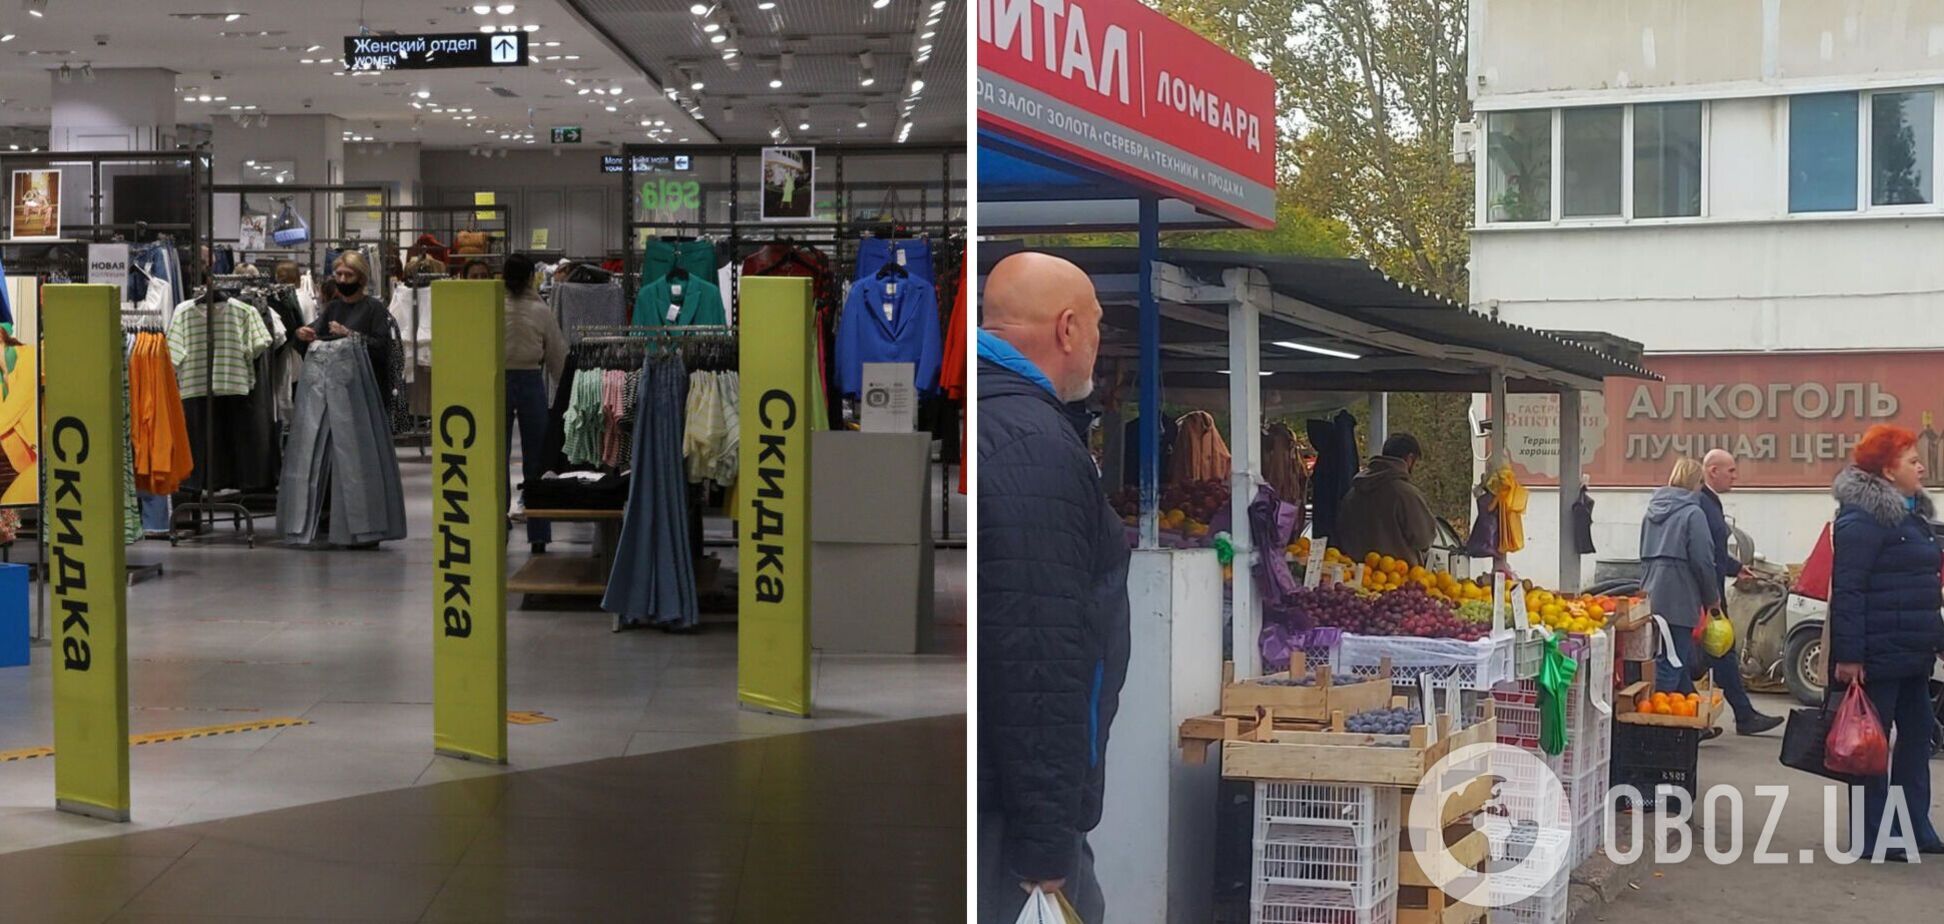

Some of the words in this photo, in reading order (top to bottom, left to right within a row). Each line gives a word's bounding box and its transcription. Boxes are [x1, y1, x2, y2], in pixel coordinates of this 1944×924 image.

[353, 37, 426, 54] Женский
[430, 38, 477, 54] отдел
[354, 55, 397, 67] WOMEN
[1157, 71, 1260, 153] ЛОМБАРД
[999, 87, 1044, 120] ЗАЛОГ
[1154, 150, 1199, 181] ТЕХНИКИ
[1207, 172, 1245, 199] ПРОДАЖА
[91, 261, 125, 270] НОВАЯ
[1626, 382, 1898, 419] АЛКОГОЛЬ
[1625, 433, 1777, 460] ЛУЧШАЯ
[1790, 433, 1856, 463] ЦЕН
[438, 404, 477, 639] Скидка
[751, 388, 797, 605] Скидка
[52, 416, 91, 673] Скидка
